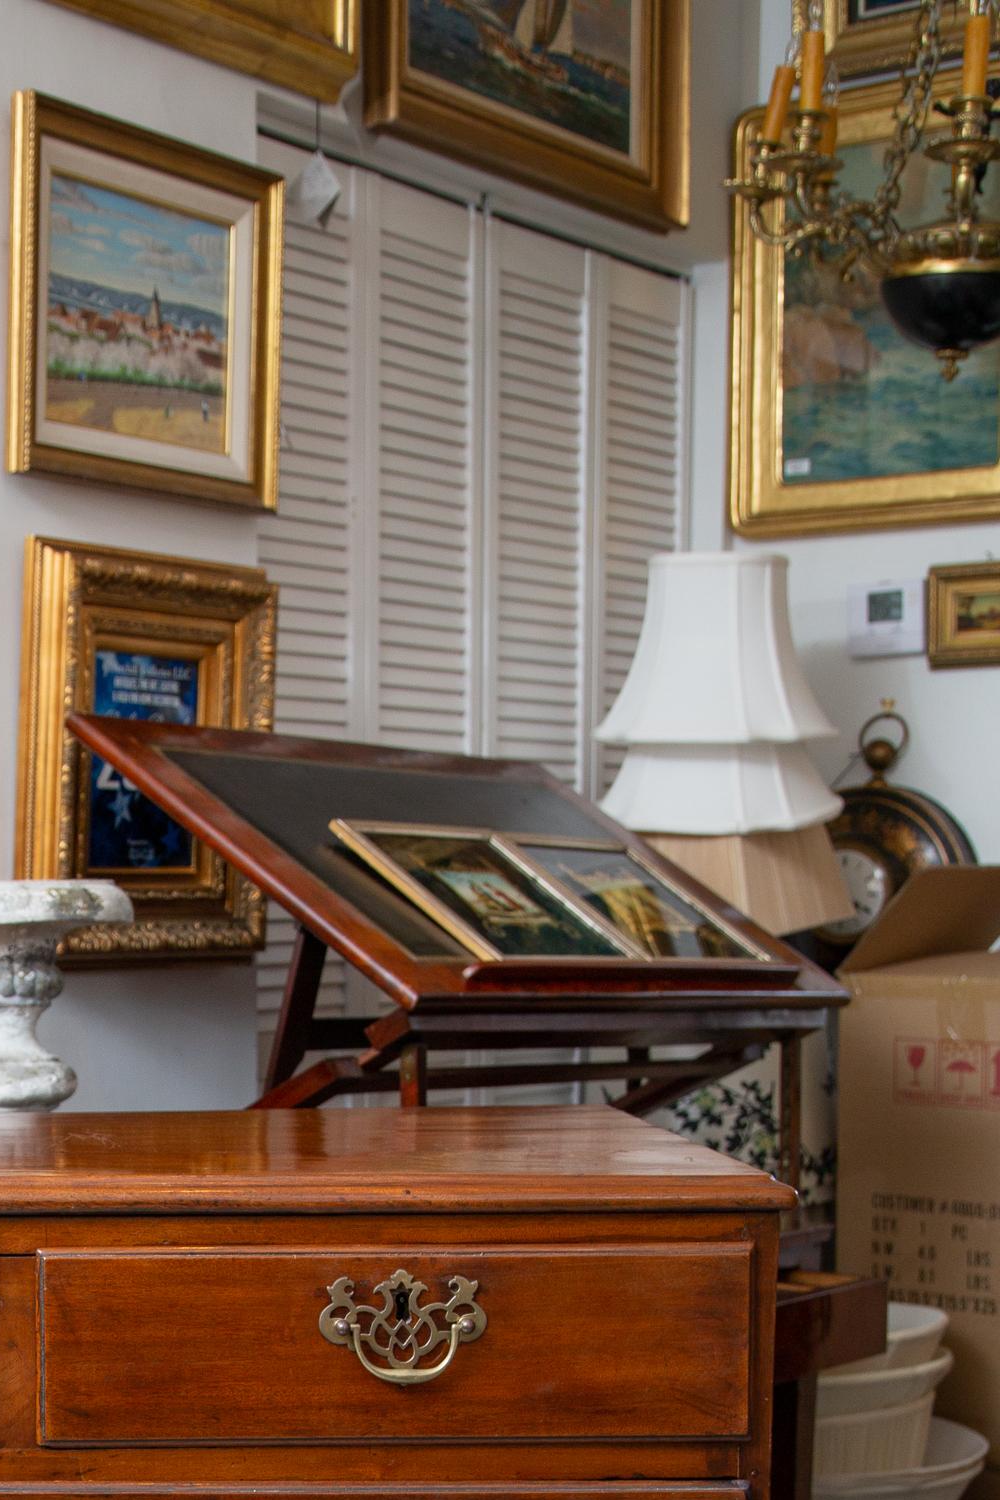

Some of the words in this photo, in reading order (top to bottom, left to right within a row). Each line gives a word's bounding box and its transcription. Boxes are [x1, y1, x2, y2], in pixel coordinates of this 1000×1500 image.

[871, 1191, 936, 1213] CUSTOMER
[951, 1223, 968, 1240] PC
[966, 1248, 991, 1267] LBS
[966, 1273, 991, 1291] LBS
